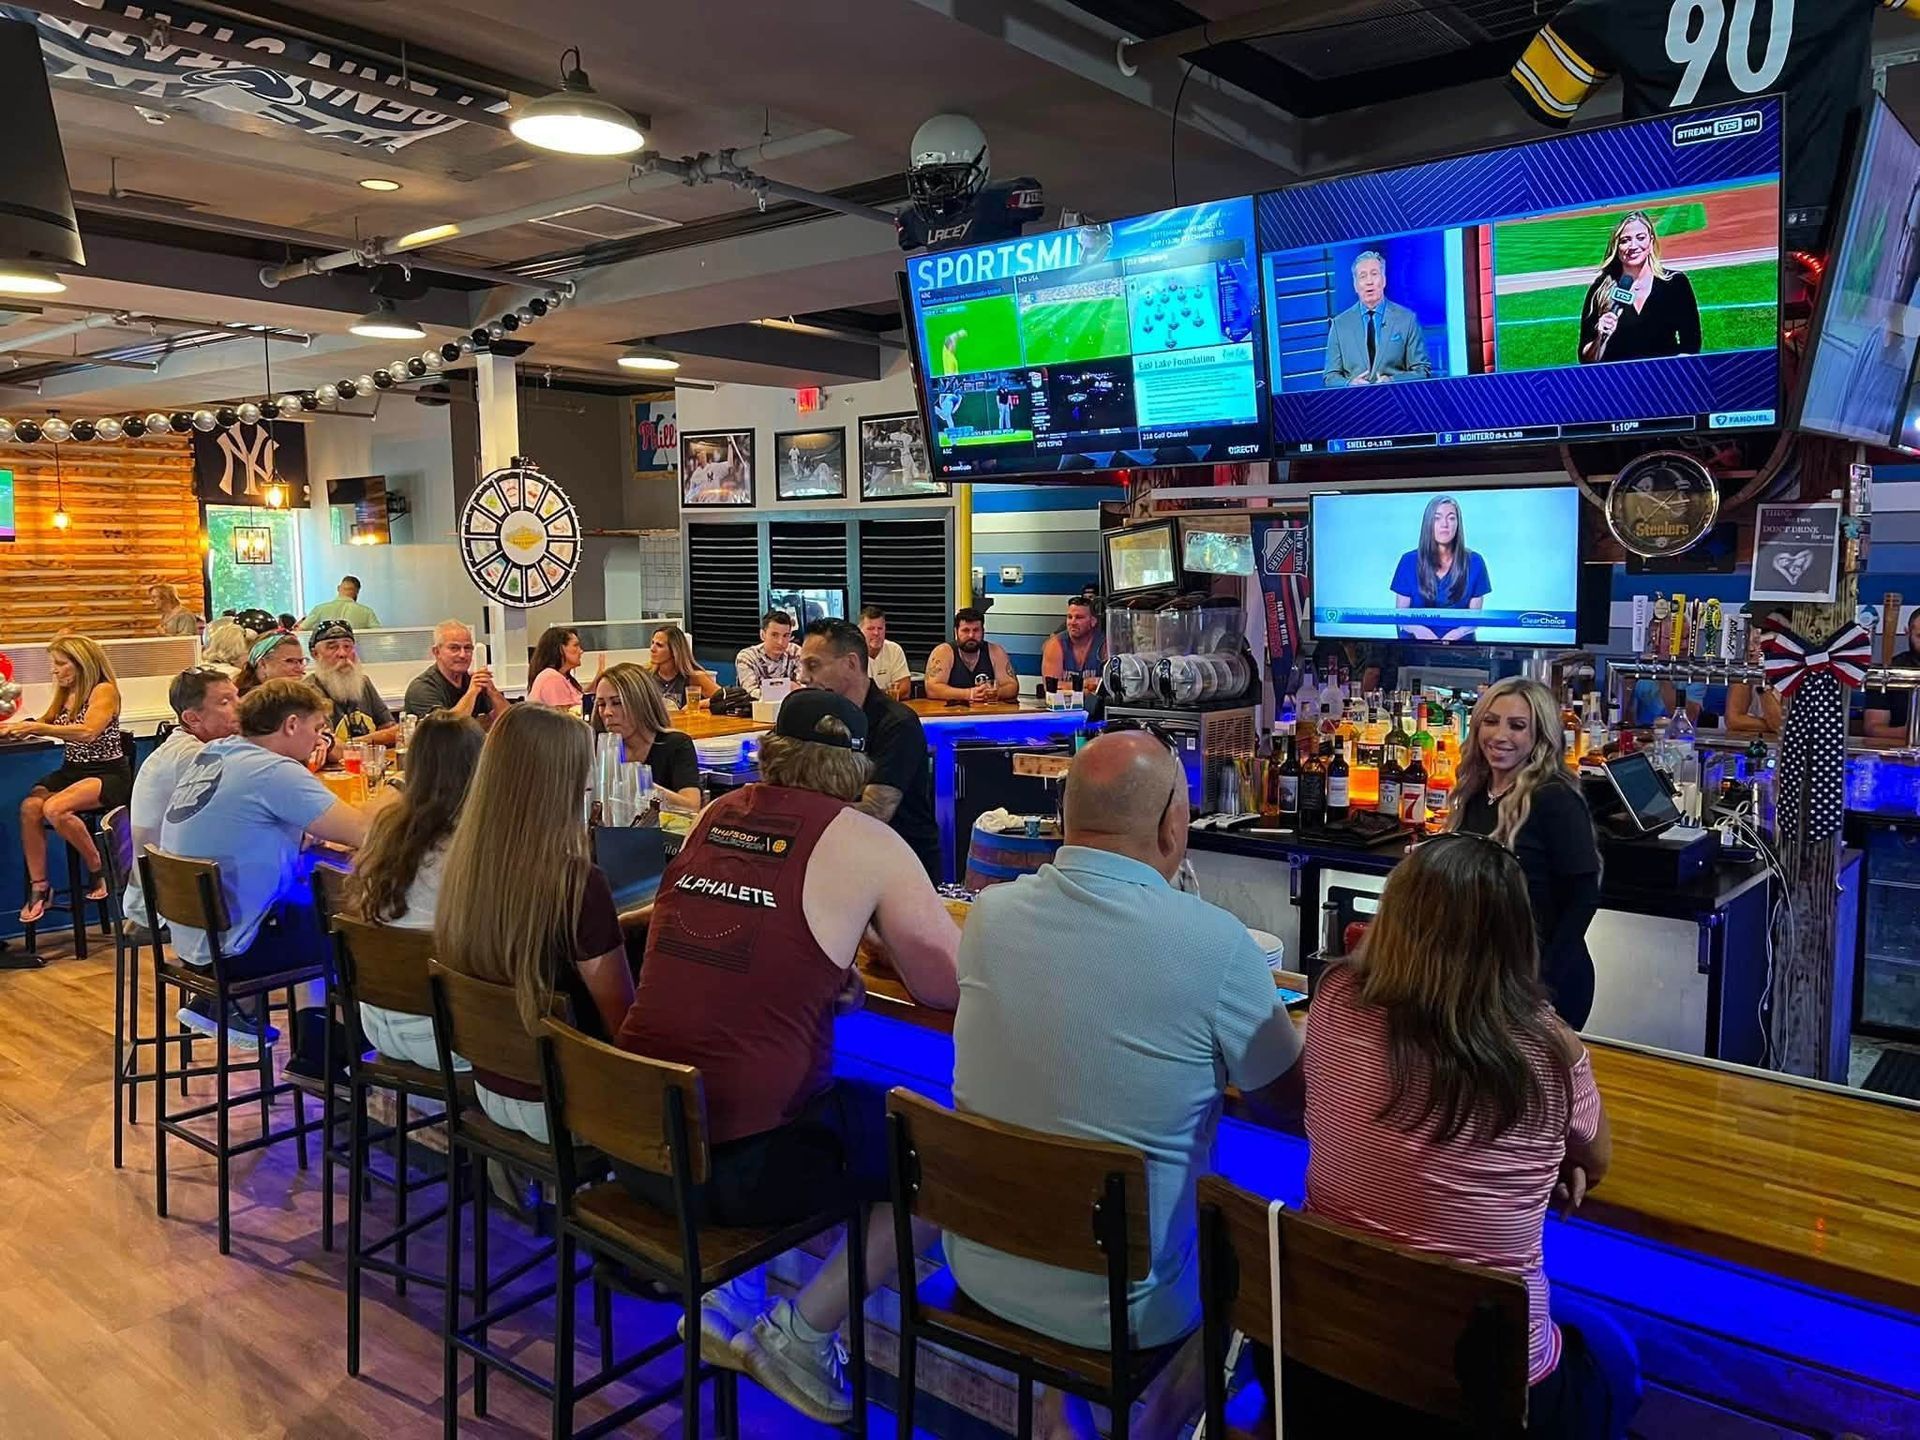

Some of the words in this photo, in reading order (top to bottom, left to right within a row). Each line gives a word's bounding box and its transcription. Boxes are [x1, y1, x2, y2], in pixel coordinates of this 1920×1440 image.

[1665, 0, 1794, 107] 90
[1677, 126, 1712, 140] STREAM
[1718, 121, 1739, 131] YES
[1744, 117, 1758, 128] ON
[927, 219, 973, 245] LACEY
[917, 233, 1081, 292] SPORTSMI
[1154, 358, 1171, 370] Lake
[1173, 354, 1216, 368] Foundation
[1728, 413, 1770, 425] FANDUEL
[1154, 431, 1165, 440] Golf
[1166, 430, 1189, 440] Channel
[1346, 440, 1368, 449] SNELL
[1227, 443, 1260, 455] DIRECTV
[1635, 521, 1690, 537] Steelers
[1791, 525, 1820, 534] DRINK
[1294, 531, 1304, 549] NEW
[1267, 536, 1294, 571] RANGERS
[1294, 549, 1304, 573] YORK
[1276, 600, 1286, 621] NEW
[1521, 616, 1567, 625] ClearChoice
[1279, 623, 1290, 646] YORK
[1403, 793, 1422, 819] 7
[710, 826, 760, 843] RHAPSODY
[673, 873, 778, 908] ALPHALETE
